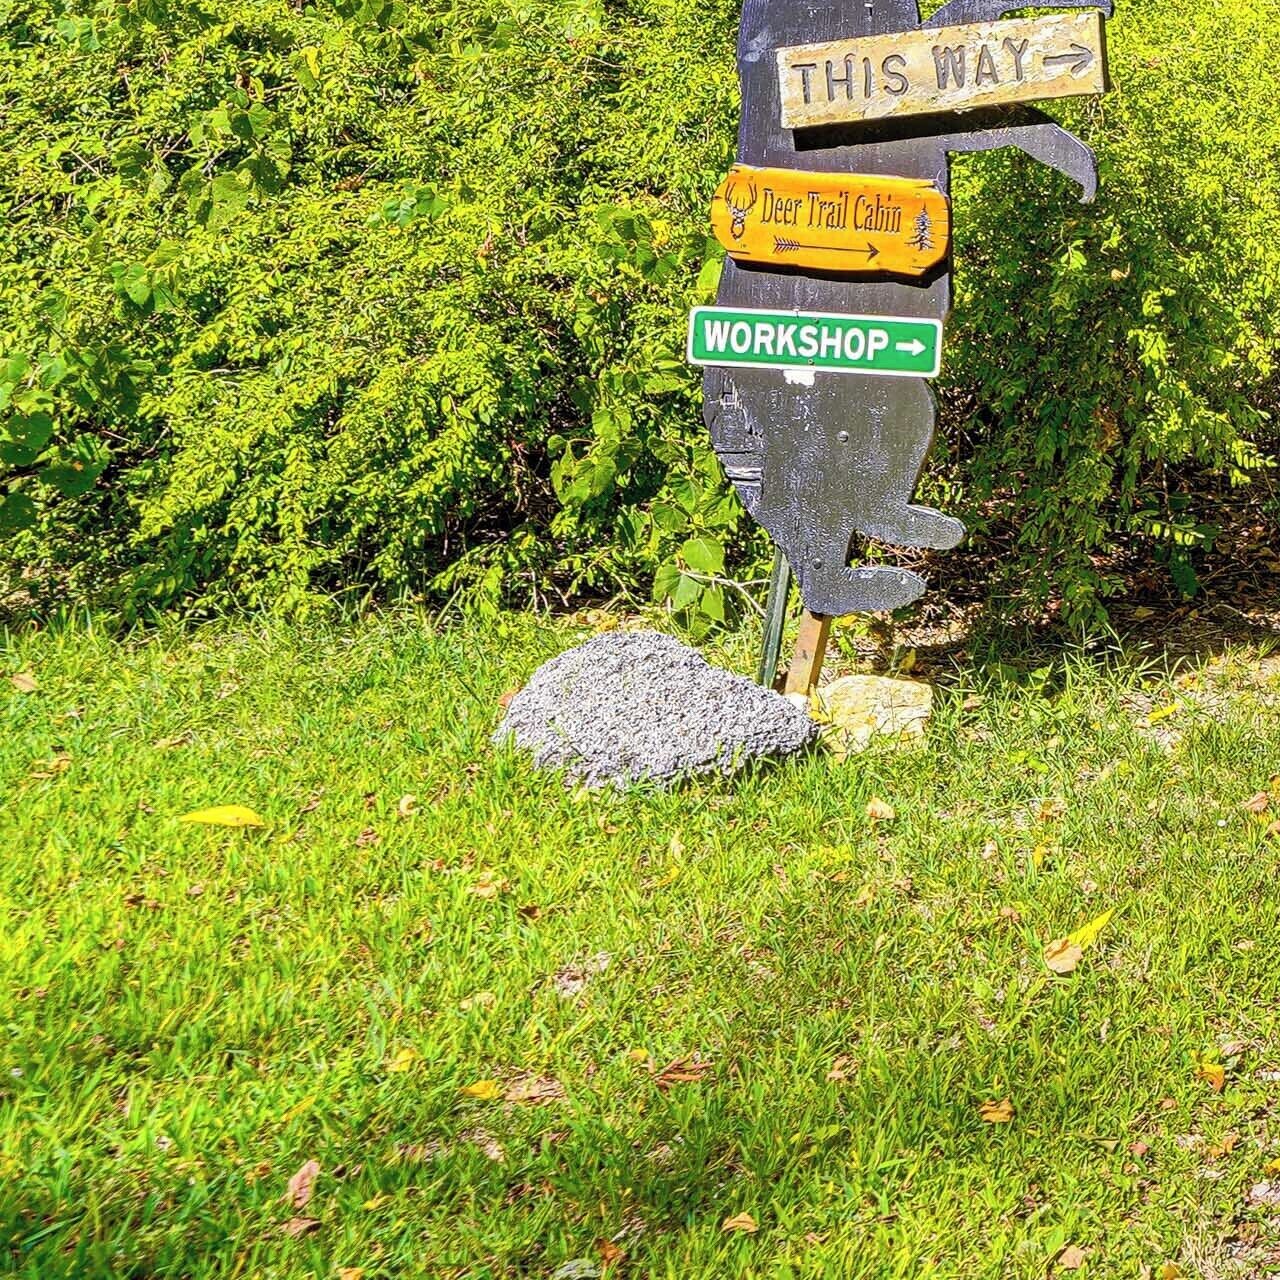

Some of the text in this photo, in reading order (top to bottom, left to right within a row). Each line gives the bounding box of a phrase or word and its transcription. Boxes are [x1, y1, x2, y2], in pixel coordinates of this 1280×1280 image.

[791, 37, 1030, 104] THIS WAY
[760, 188, 902, 234] Deer Trail Cabin
[704, 319, 889, 361] WORKSHOP
